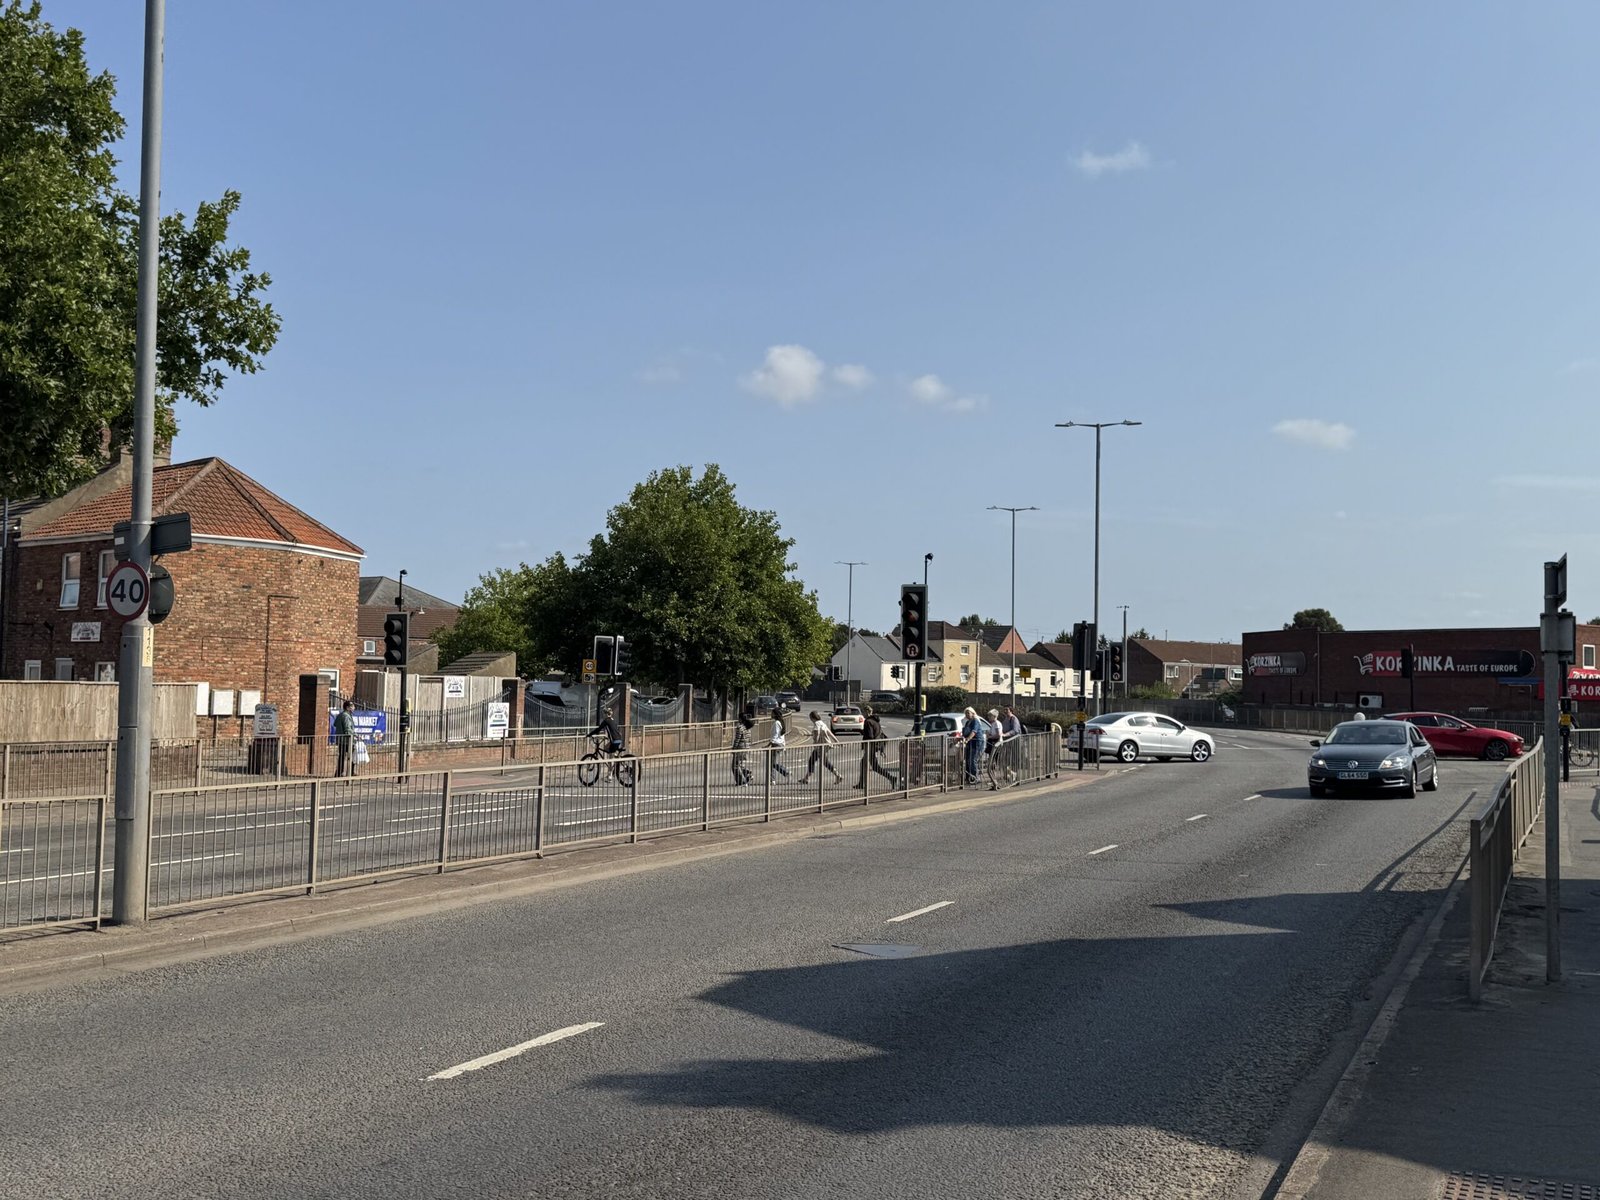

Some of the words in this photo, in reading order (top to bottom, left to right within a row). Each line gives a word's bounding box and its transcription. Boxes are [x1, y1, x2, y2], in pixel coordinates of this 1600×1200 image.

[111, 579, 144, 603] 40
[1254, 655, 1281, 667] KORZINKA
[1376, 656, 1455, 672] KORINKA
[1456, 664, 1478, 672] TASTE
[1480, 664, 1488, 672] OF
[1490, 664, 1518, 672] EUROPE
